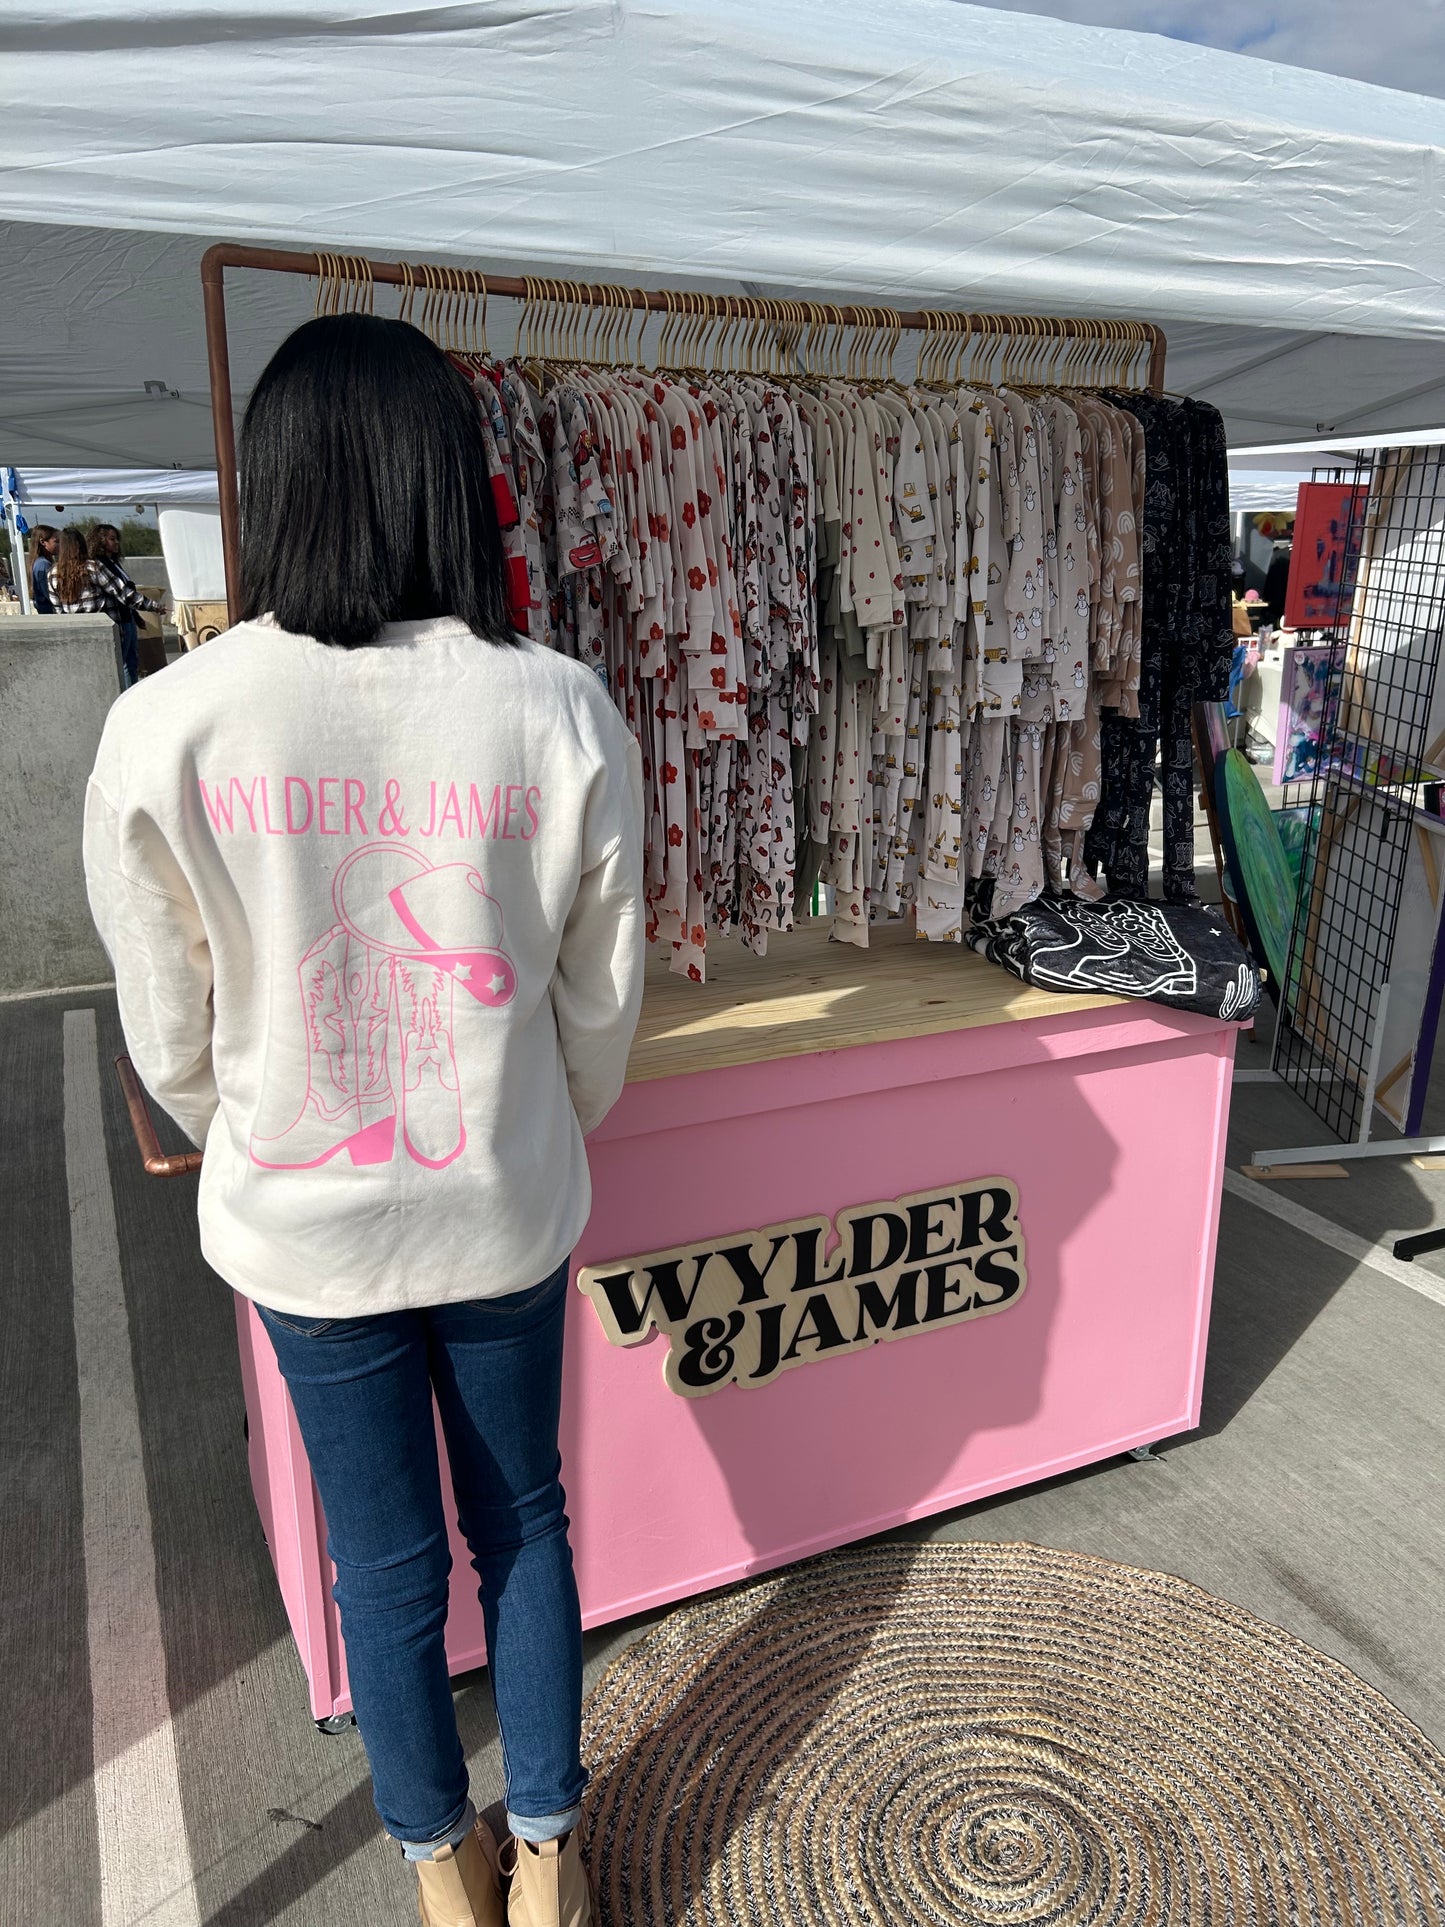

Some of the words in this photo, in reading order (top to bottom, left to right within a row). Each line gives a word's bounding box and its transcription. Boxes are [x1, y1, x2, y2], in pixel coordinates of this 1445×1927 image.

[199, 776, 368, 835] WYLDER
[378, 779, 411, 836] &
[419, 781, 542, 841] JAMES
[594, 1187, 1014, 1334] WYLDER
